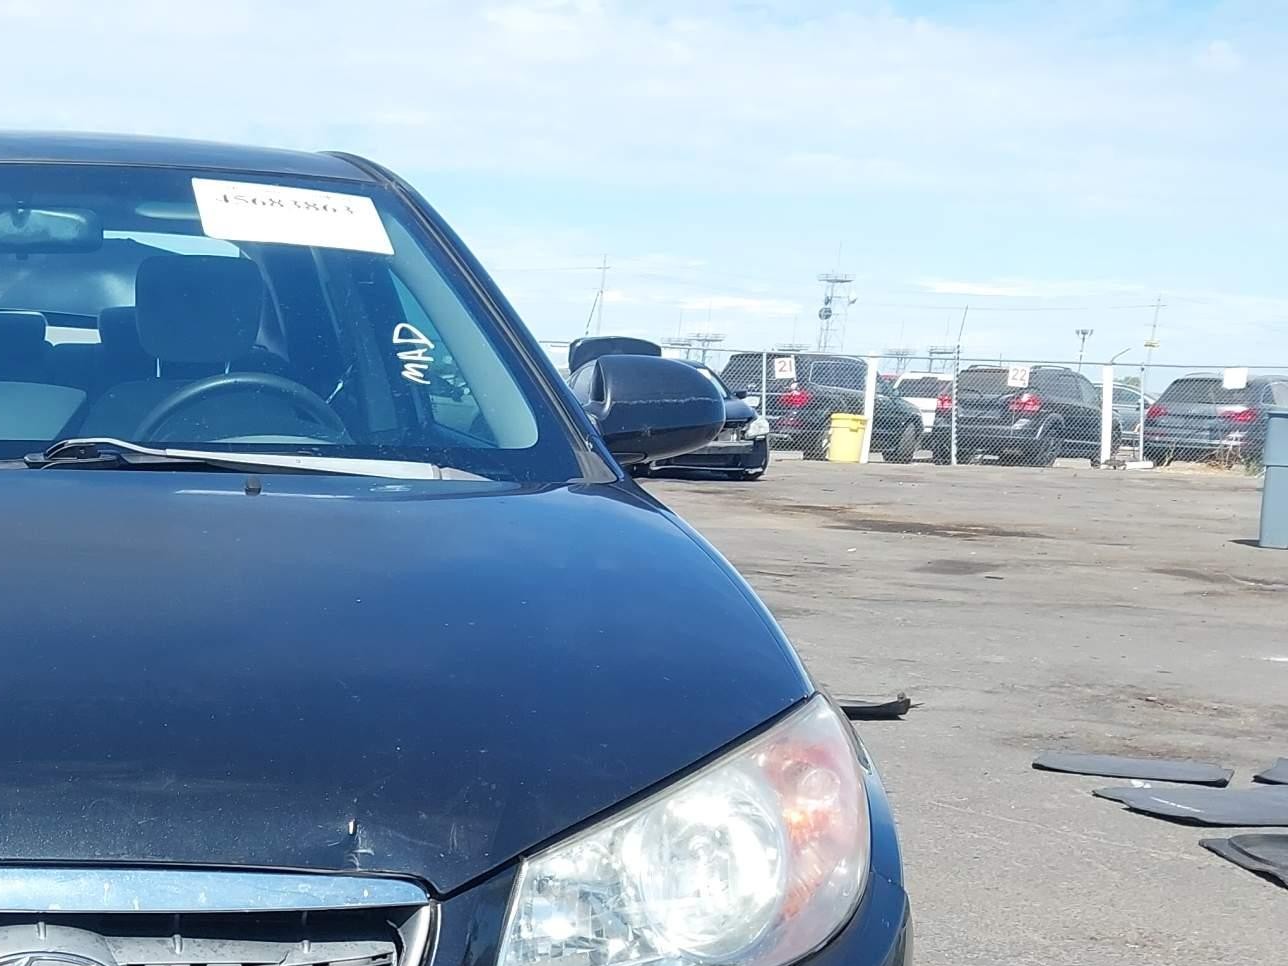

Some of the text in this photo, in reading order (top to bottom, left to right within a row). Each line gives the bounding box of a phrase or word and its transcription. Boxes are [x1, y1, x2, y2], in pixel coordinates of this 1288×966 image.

[392, 322, 435, 385] MAD
[777, 359, 792, 372] 21
[1011, 367, 1027, 381] 22
